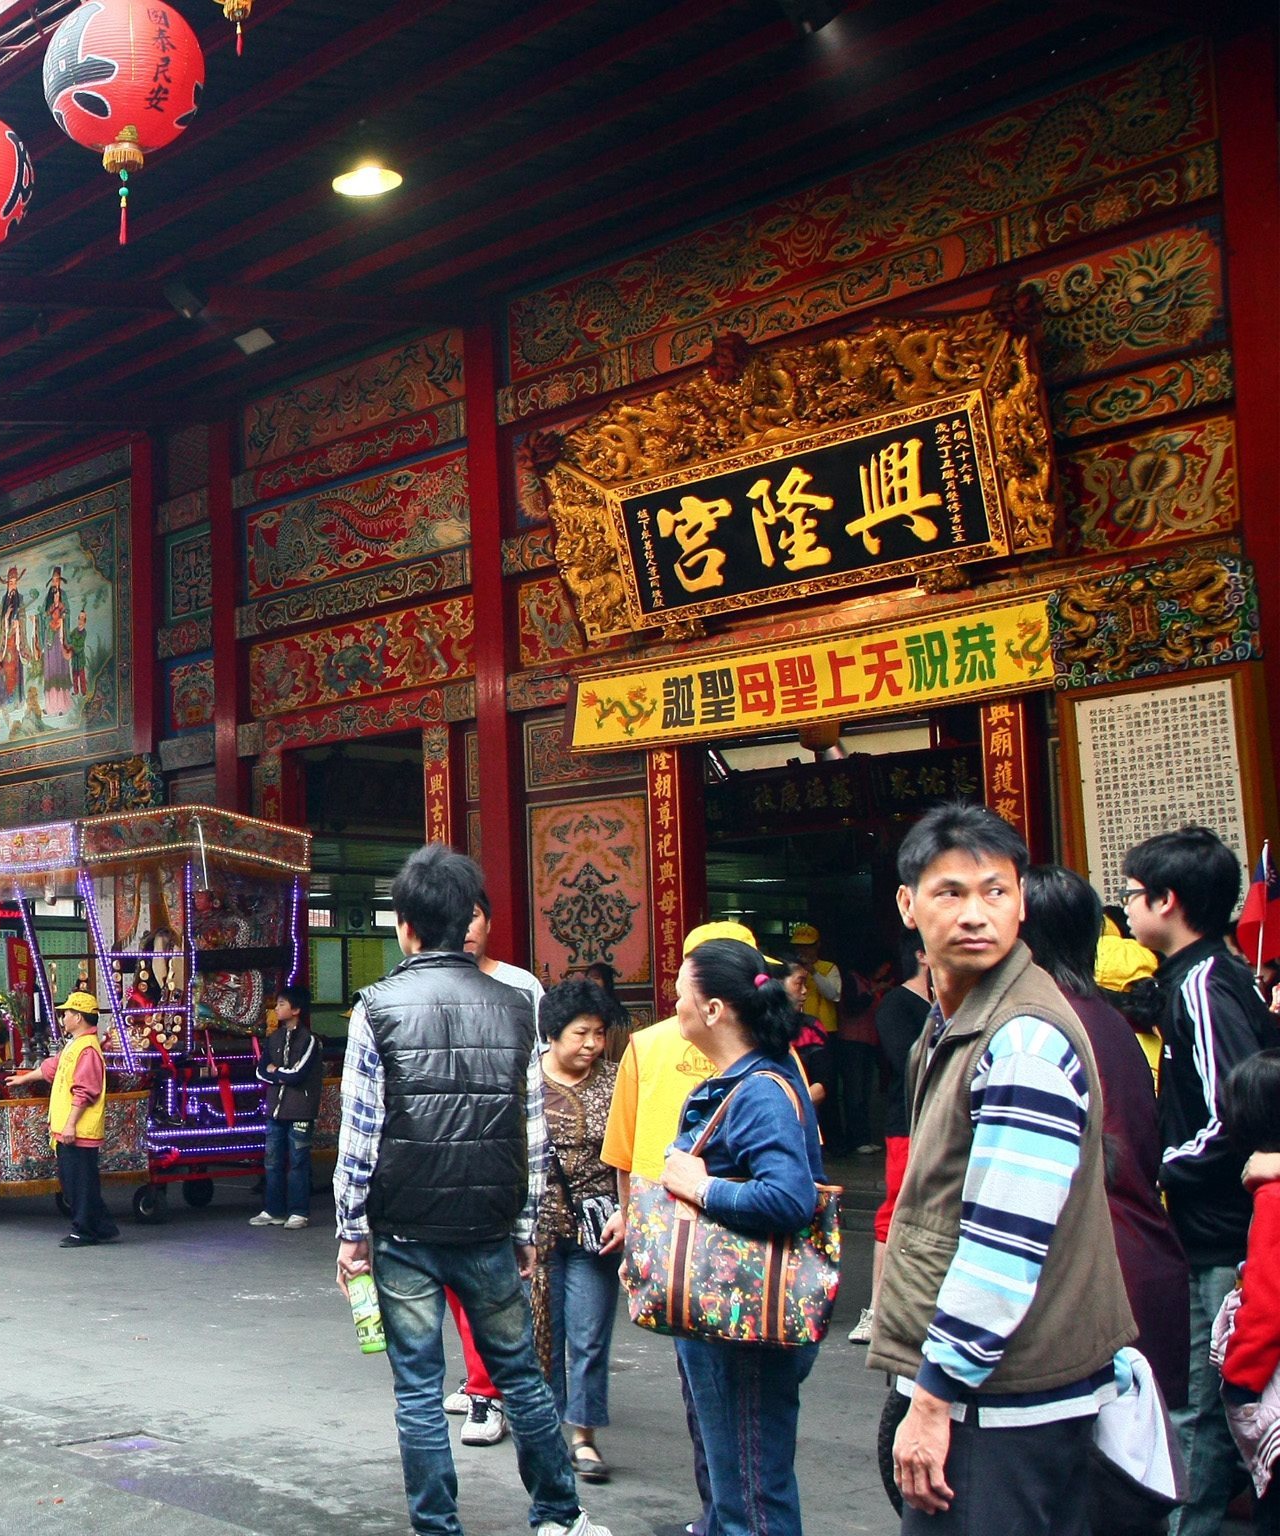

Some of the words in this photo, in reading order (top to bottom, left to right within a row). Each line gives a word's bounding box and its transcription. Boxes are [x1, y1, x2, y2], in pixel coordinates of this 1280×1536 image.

[656, 437, 942, 593] 興隆宮
[661, 623, 997, 731] 恭祝天上聖母聖誕
